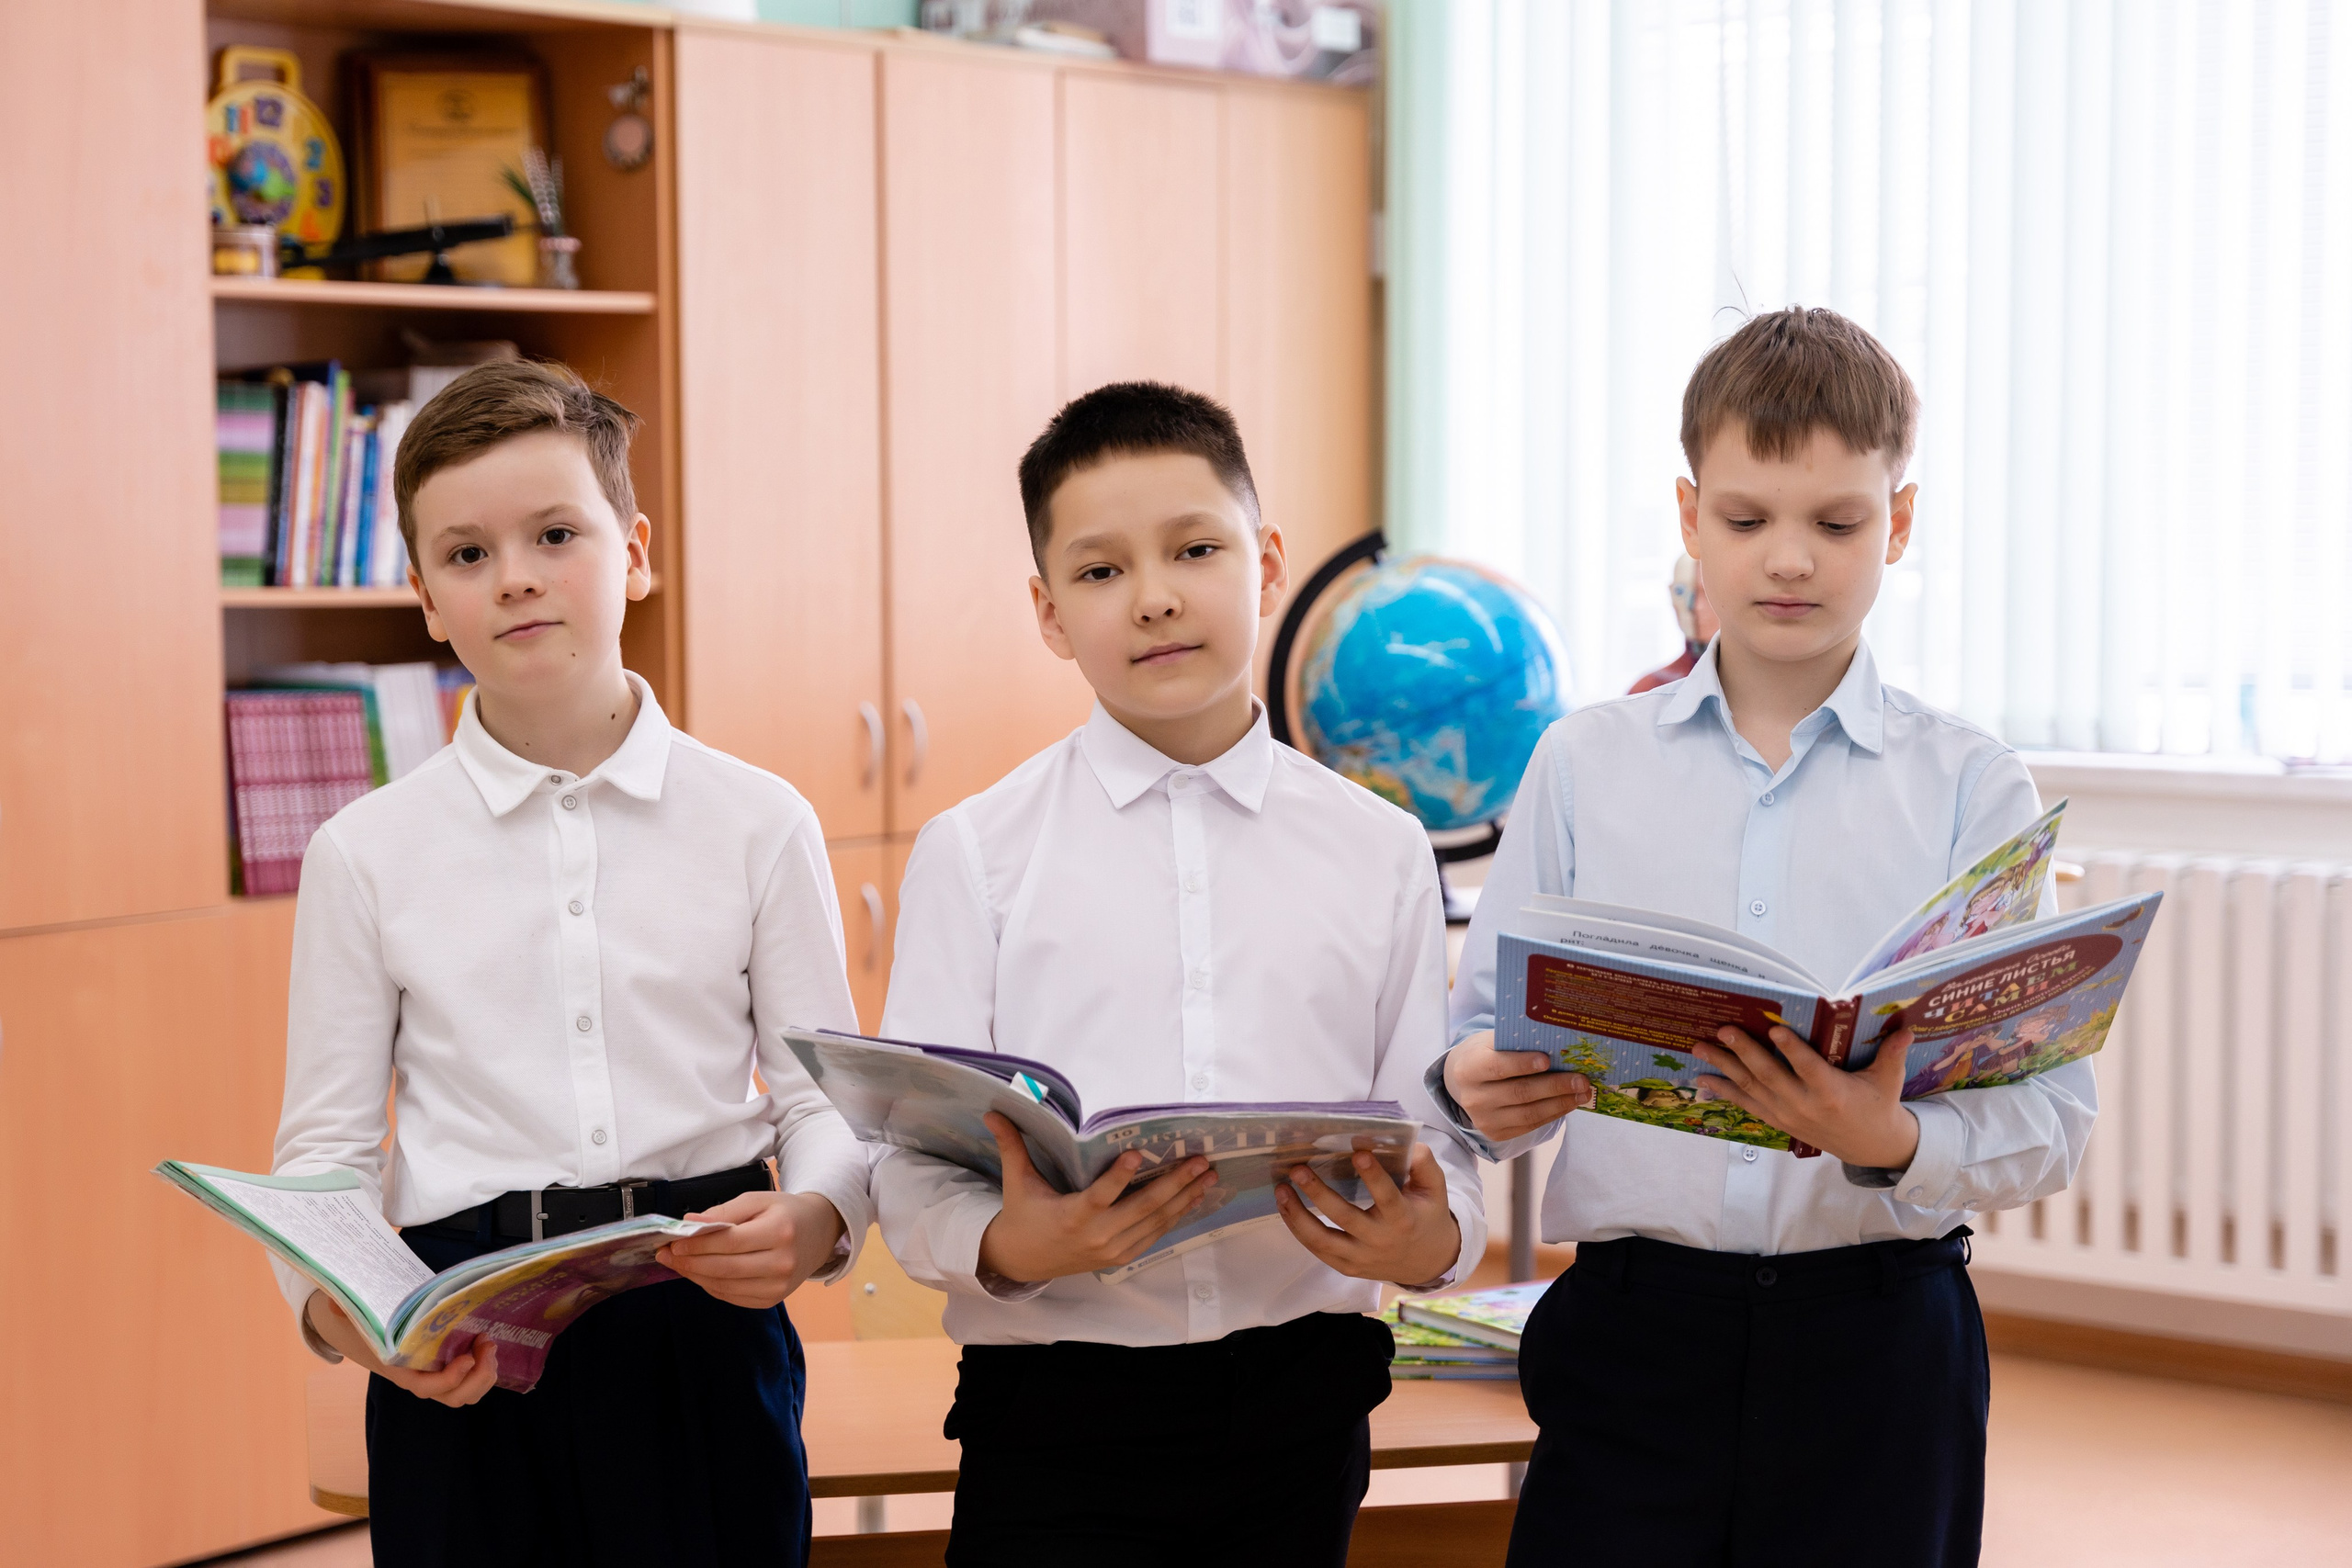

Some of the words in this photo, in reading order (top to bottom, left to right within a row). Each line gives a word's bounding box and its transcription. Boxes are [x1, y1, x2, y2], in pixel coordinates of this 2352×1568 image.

[1573, 931, 1639, 946] Погладила
[1649, 944, 1700, 958] девочка
[1710, 957, 1747, 973] щенка
[1924, 962, 2077, 1018] ЧИТАЕМ
[1928, 980, 1995, 1007] СИНИЕ
[1999, 950, 2075, 985] ЛИСТЬЯ
[1944, 981, 2049, 1022] САМИ
[1112, 1130, 1133, 1140] 10
[489, 1321, 552, 1349] ЛИТЕРАТУРНОЕ
